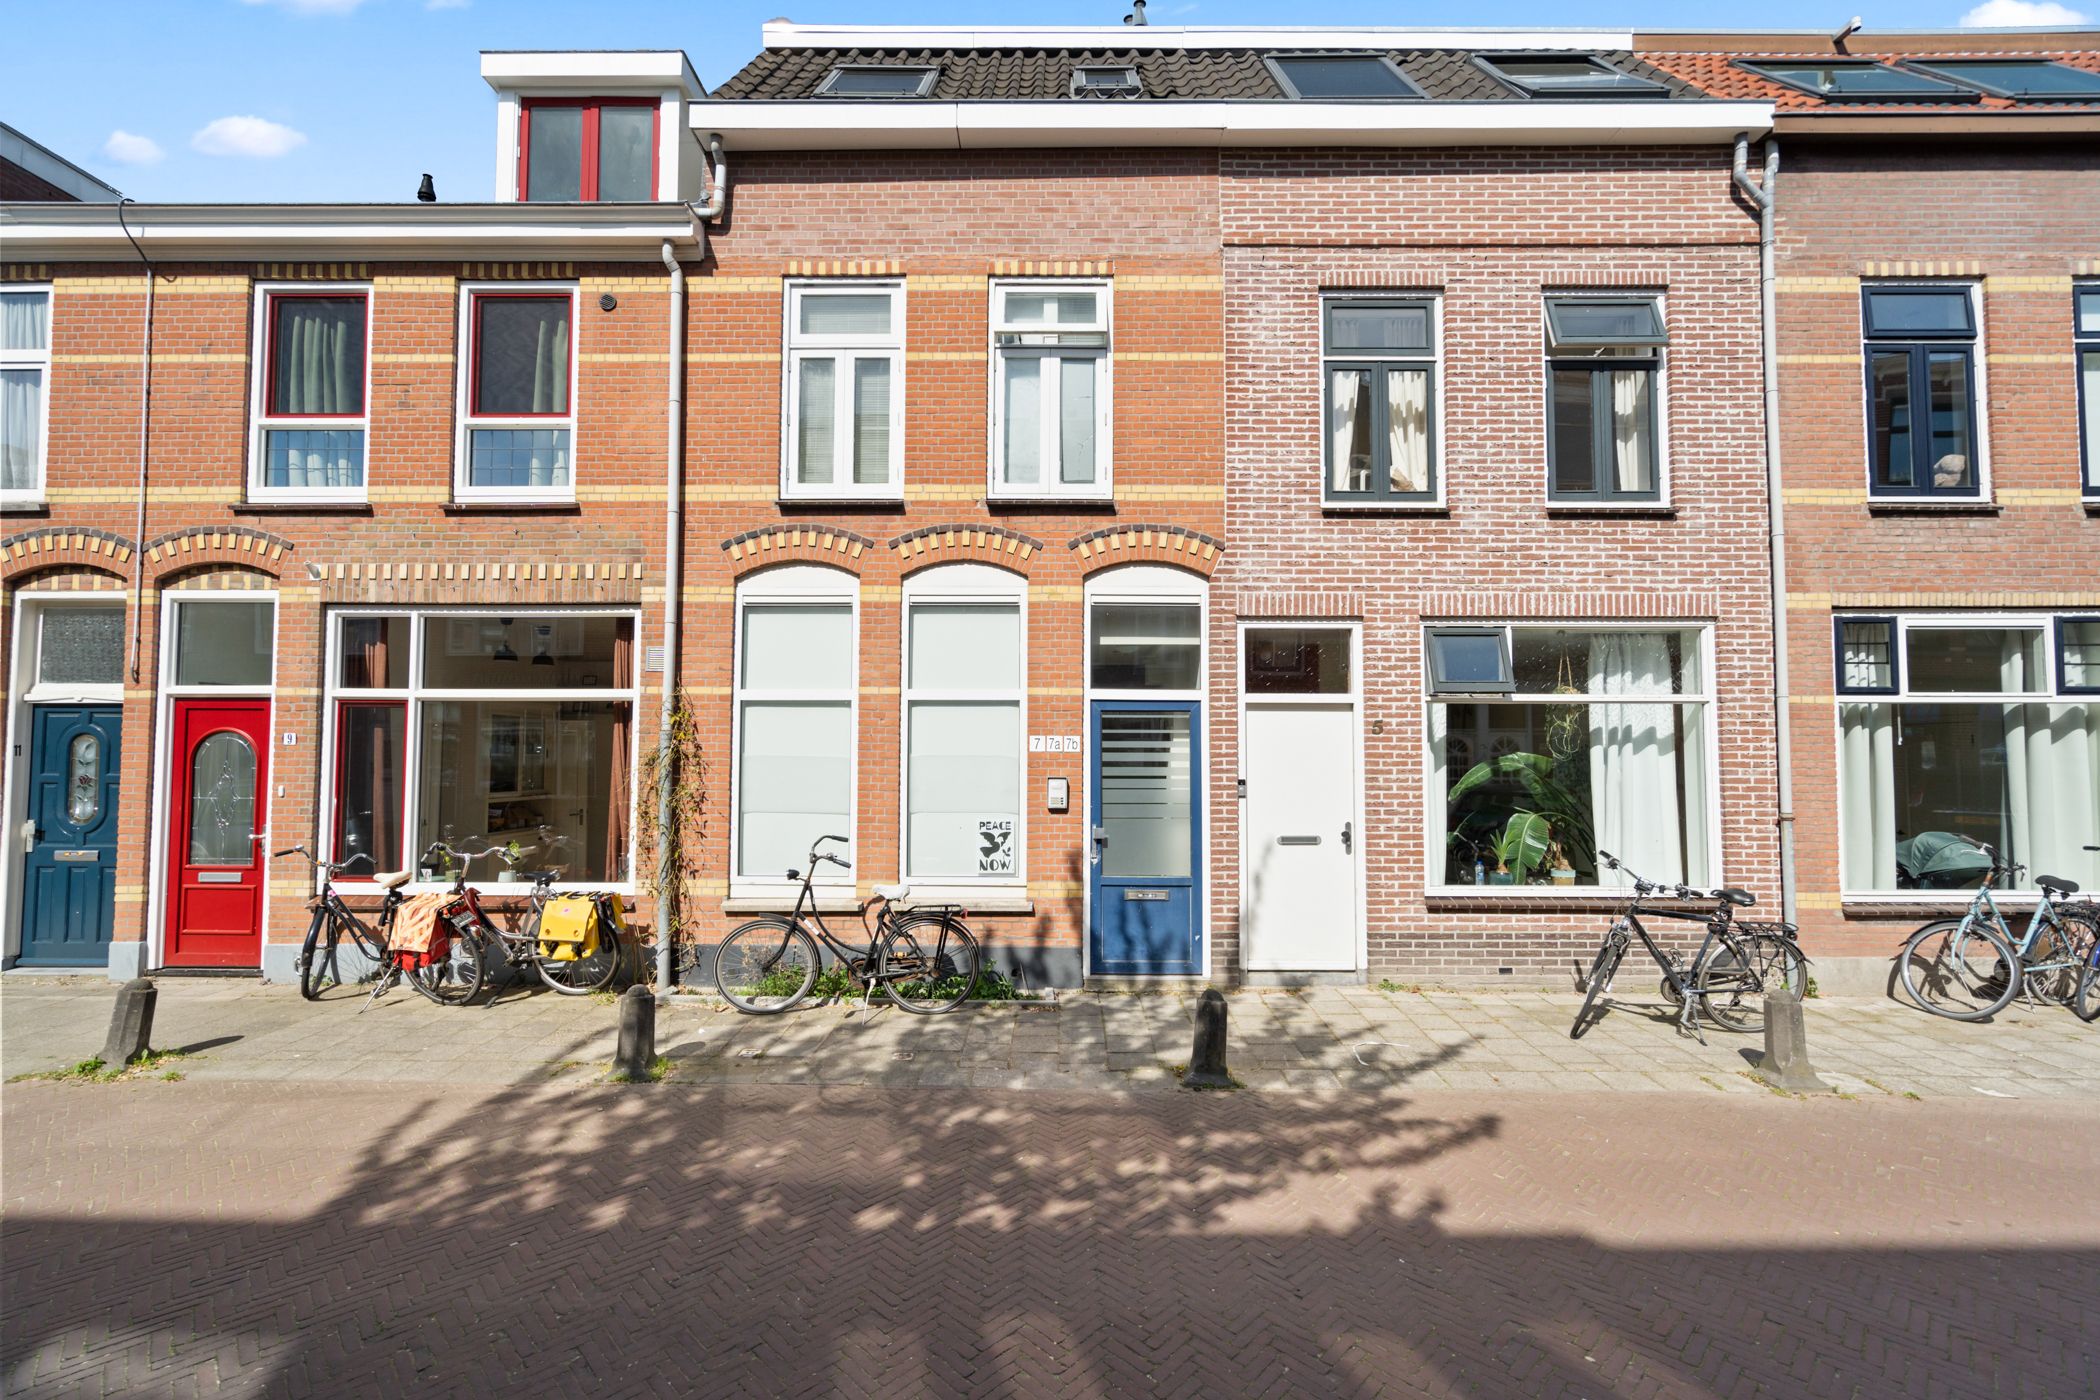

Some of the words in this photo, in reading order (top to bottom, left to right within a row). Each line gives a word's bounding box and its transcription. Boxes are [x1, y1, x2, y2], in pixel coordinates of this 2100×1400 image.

[1372, 720, 1383, 735] 5
[287, 734, 292, 744] 9
[1034, 737, 1041, 750] 7
[1049, 737, 1061, 750] 7a
[1066, 737, 1078, 750] 7b
[14, 744, 21, 756] 11
[979, 821, 1011, 831] PEACE
[979, 859, 1011, 871] NOW
